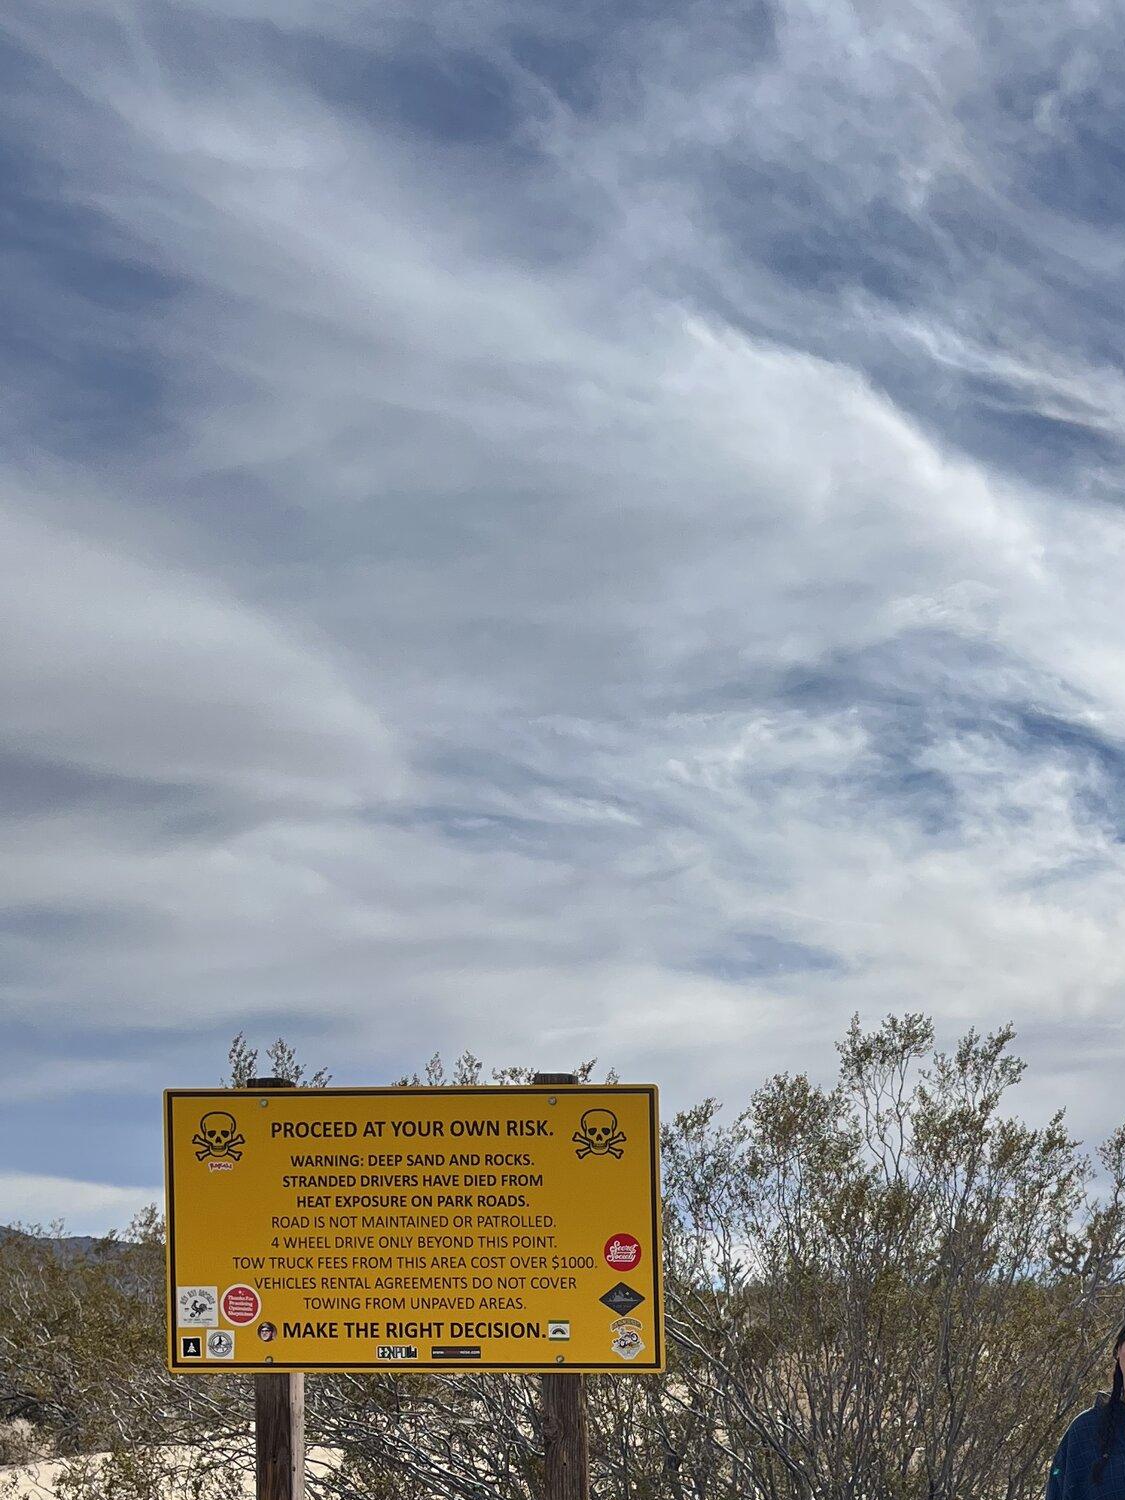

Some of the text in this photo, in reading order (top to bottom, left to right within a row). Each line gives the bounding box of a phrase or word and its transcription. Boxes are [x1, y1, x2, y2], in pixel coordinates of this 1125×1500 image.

[271, 1119, 554, 1139] PROCEED AT YOUR OWN RISK.
[290, 1153, 535, 1168] WARNING: DEEP SAND AND ROCKS.
[282, 1174, 543, 1188] STRANDED DRIVERS HAVE DIED FROM
[296, 1194, 530, 1209] HEAT EXPOSURE ON PARK ROADS.
[271, 1215, 557, 1229] ROAD IS NOT MAINTAINED OR PATROLLED.
[270, 1235, 557, 1249] 4 WHEEL DRIVE ONLY BEYOND THIS POINT.
[232, 1254, 598, 1271] TOW TRUCK FEES FROM THIS AREA COST OVER $1000.
[253, 1276, 577, 1290] VEHICLES RENTAL AGREEMENTS DO NOT COVER
[303, 1297, 527, 1310] TOWING FROM UNPAVED AREAS.
[282, 1322, 339, 1339] MAKE
[343, 1322, 380, 1339] THE
[386, 1321, 445, 1339] RIGHT
[450, 1321, 547, 1339] DECISION.
